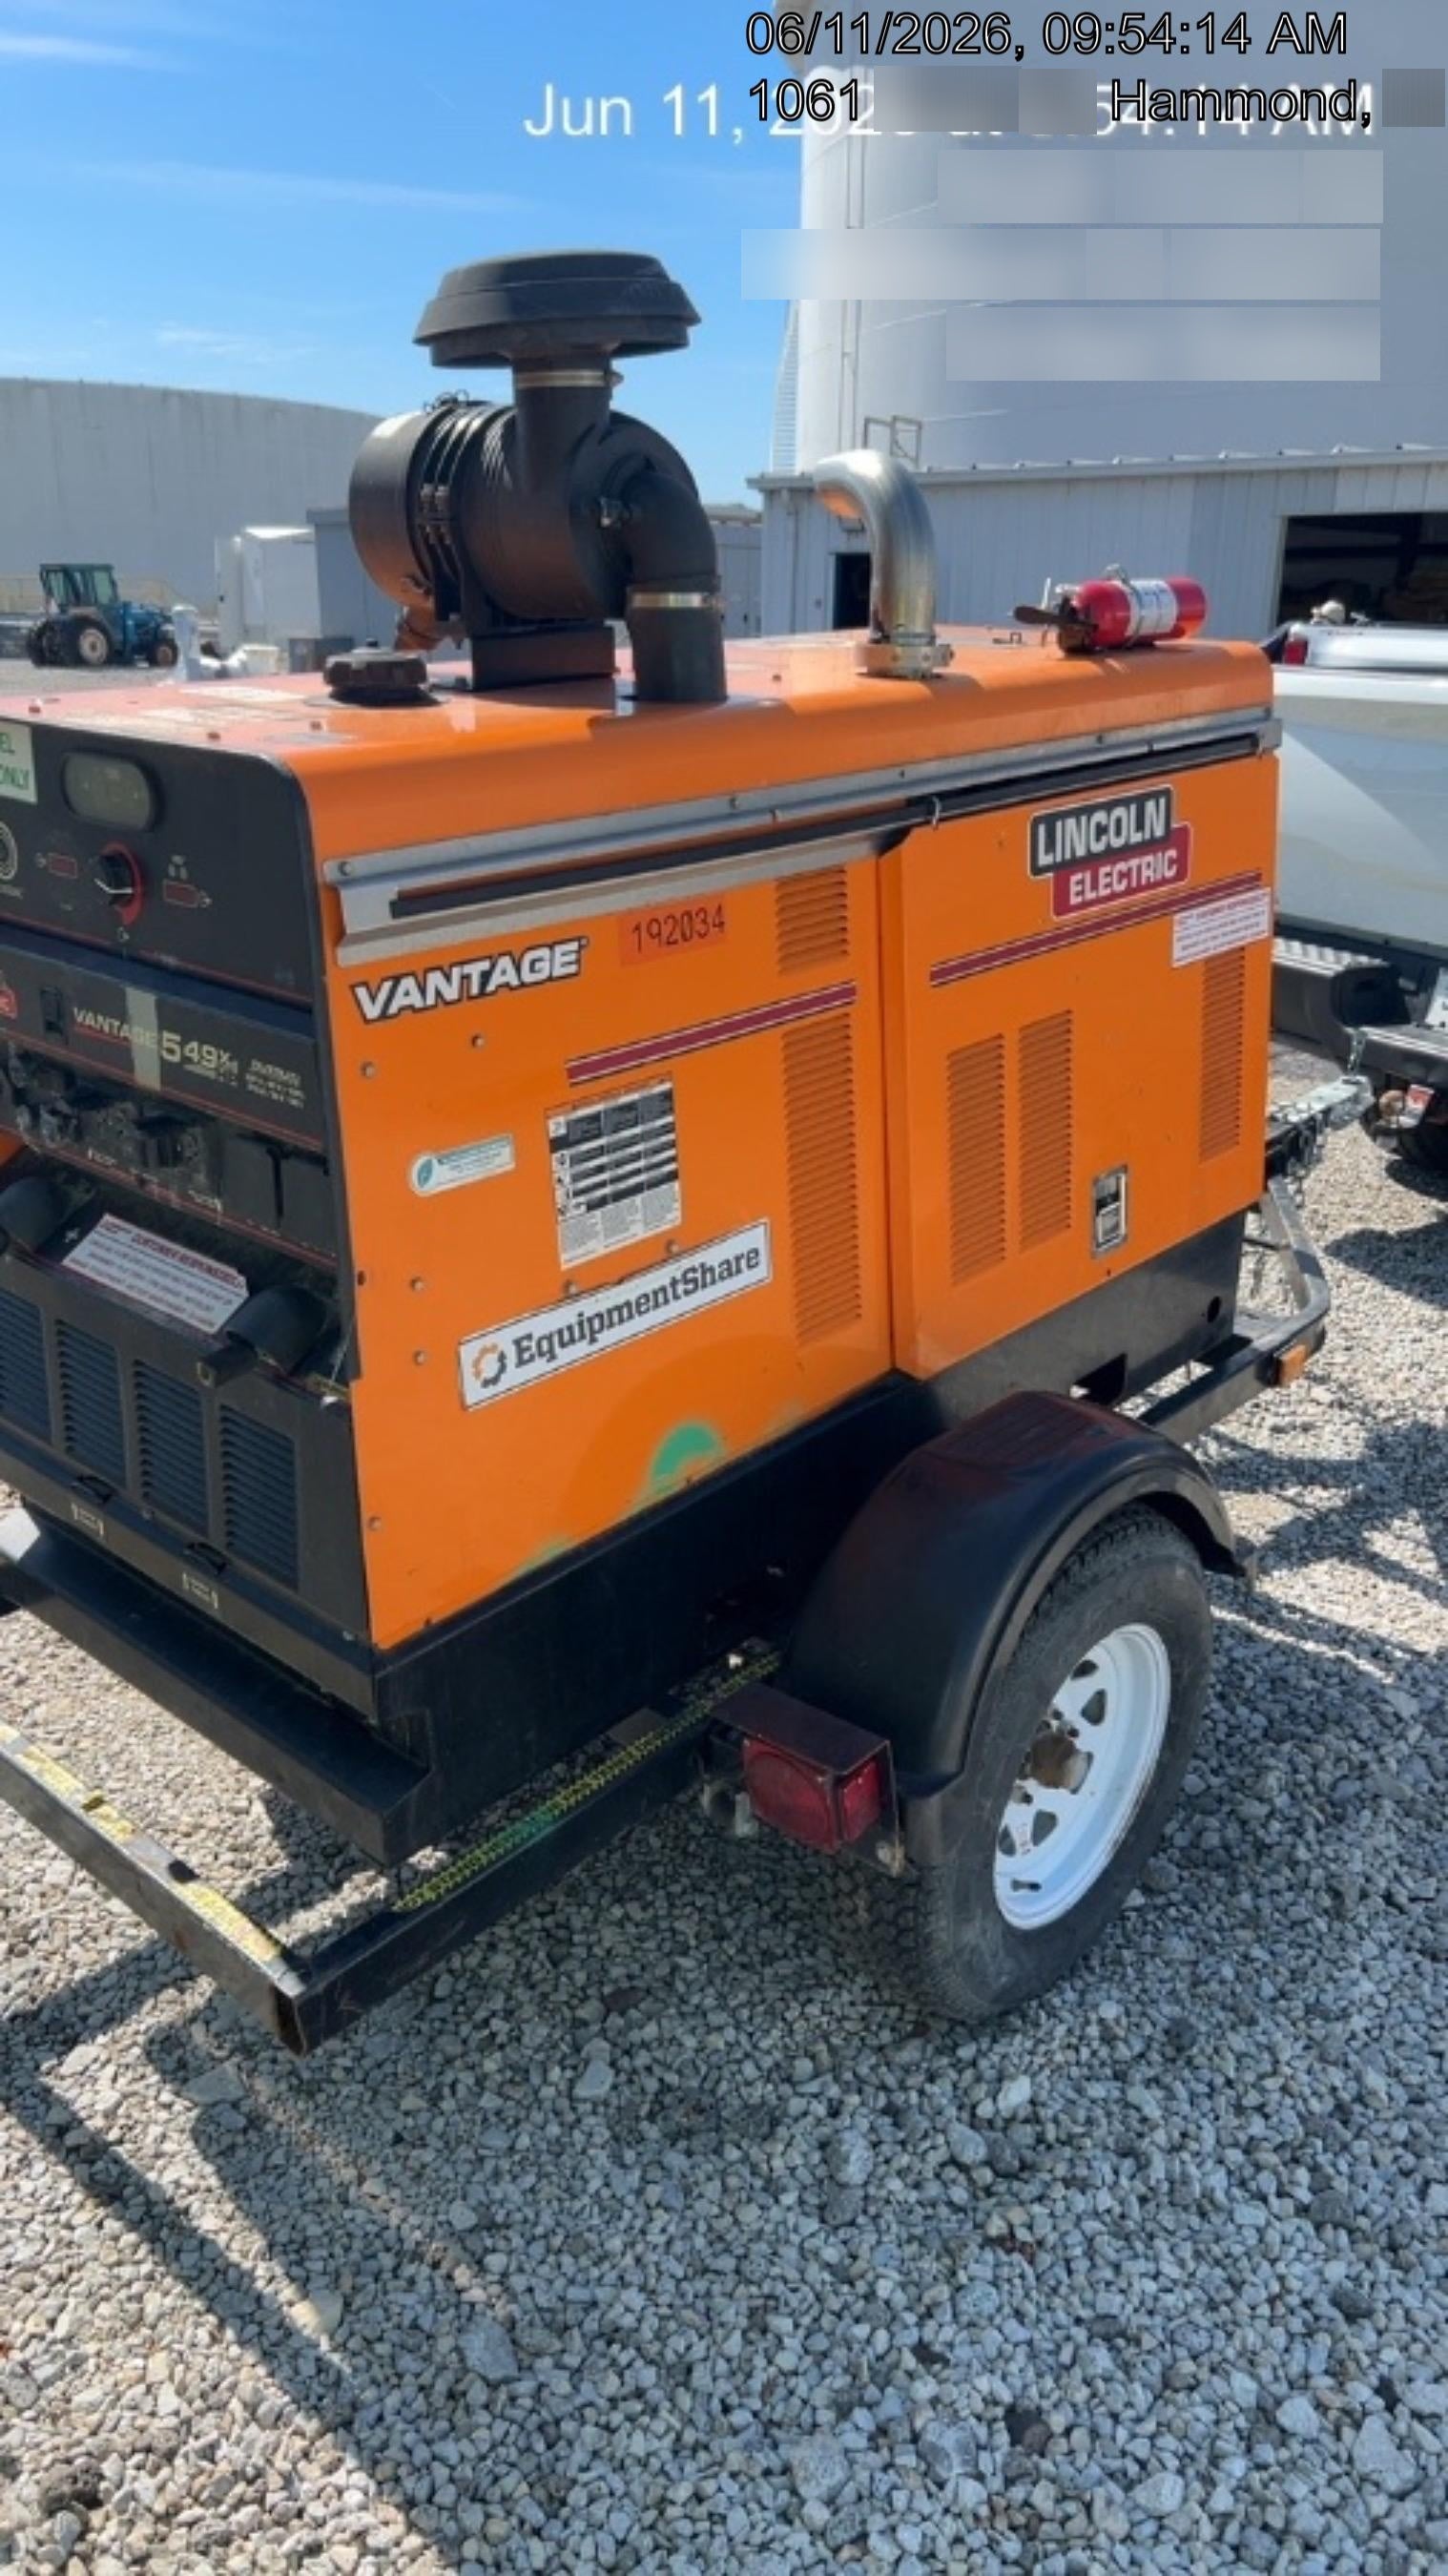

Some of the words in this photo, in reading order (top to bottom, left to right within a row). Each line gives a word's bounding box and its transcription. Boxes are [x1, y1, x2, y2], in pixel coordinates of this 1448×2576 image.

[1037, 796, 1167, 867] LINCOLN
[1068, 848, 1178, 906] ELECTRIC
[631, 903, 727, 954] 192034
[352, 939, 584, 1023] VANTAGE
[512, 1245, 761, 1374] EquipmentShare
